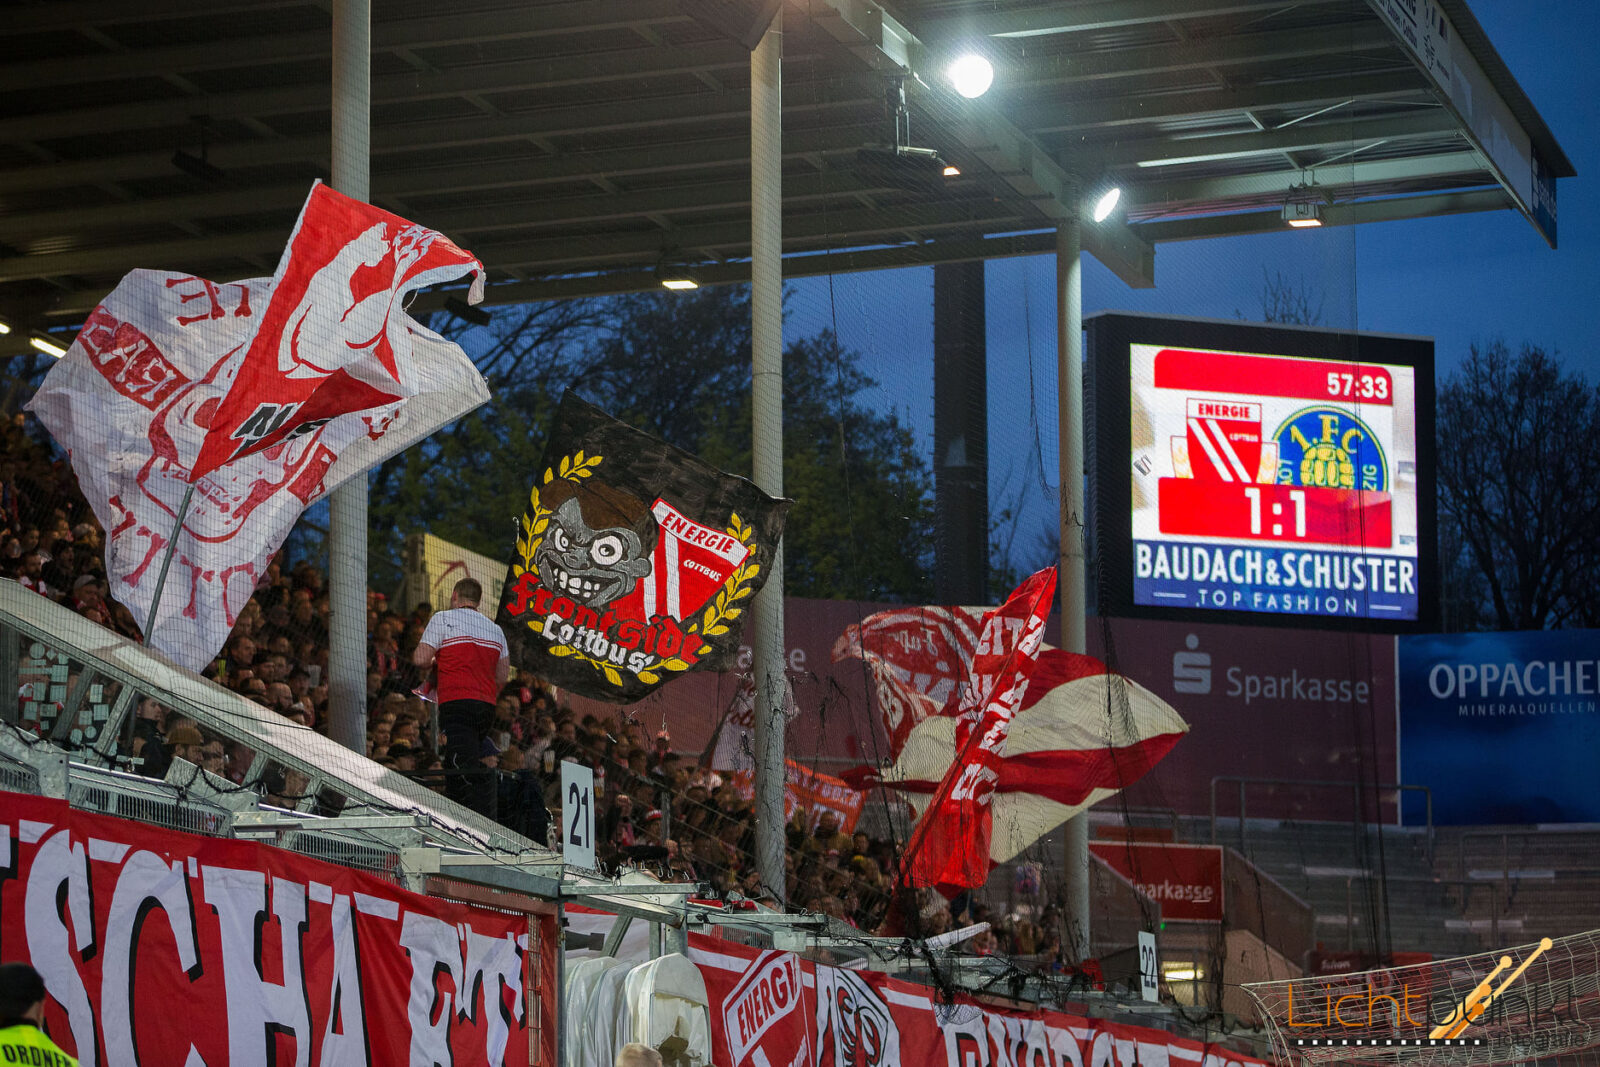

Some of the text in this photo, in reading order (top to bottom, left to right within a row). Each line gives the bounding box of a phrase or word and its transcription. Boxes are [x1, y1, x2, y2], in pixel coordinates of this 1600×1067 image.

[1327, 372, 1388, 399] 57:33
[1198, 403, 1250, 419] ENERGIE
[1244, 487, 1306, 537] 1:1
[661, 511, 735, 556] ENERGIE
[683, 559, 722, 583] COTTBUS
[1135, 544, 1415, 594] BAUDACH&SCHUSTER
[1199, 588, 1358, 614] TOP FASHION
[542, 612, 655, 675] Cottbus
[1226, 666, 1370, 704] Sparkasse
[1428, 660, 1600, 699] OPPACHE
[1458, 701, 1596, 717] MINERALQUELLEN
[569, 782, 590, 849] 21
[1134, 879, 1214, 902] parkasse
[0, 825, 528, 1067] SCHAFT
[1142, 945, 1157, 989] 22
[737, 961, 798, 1047] ENERGI
